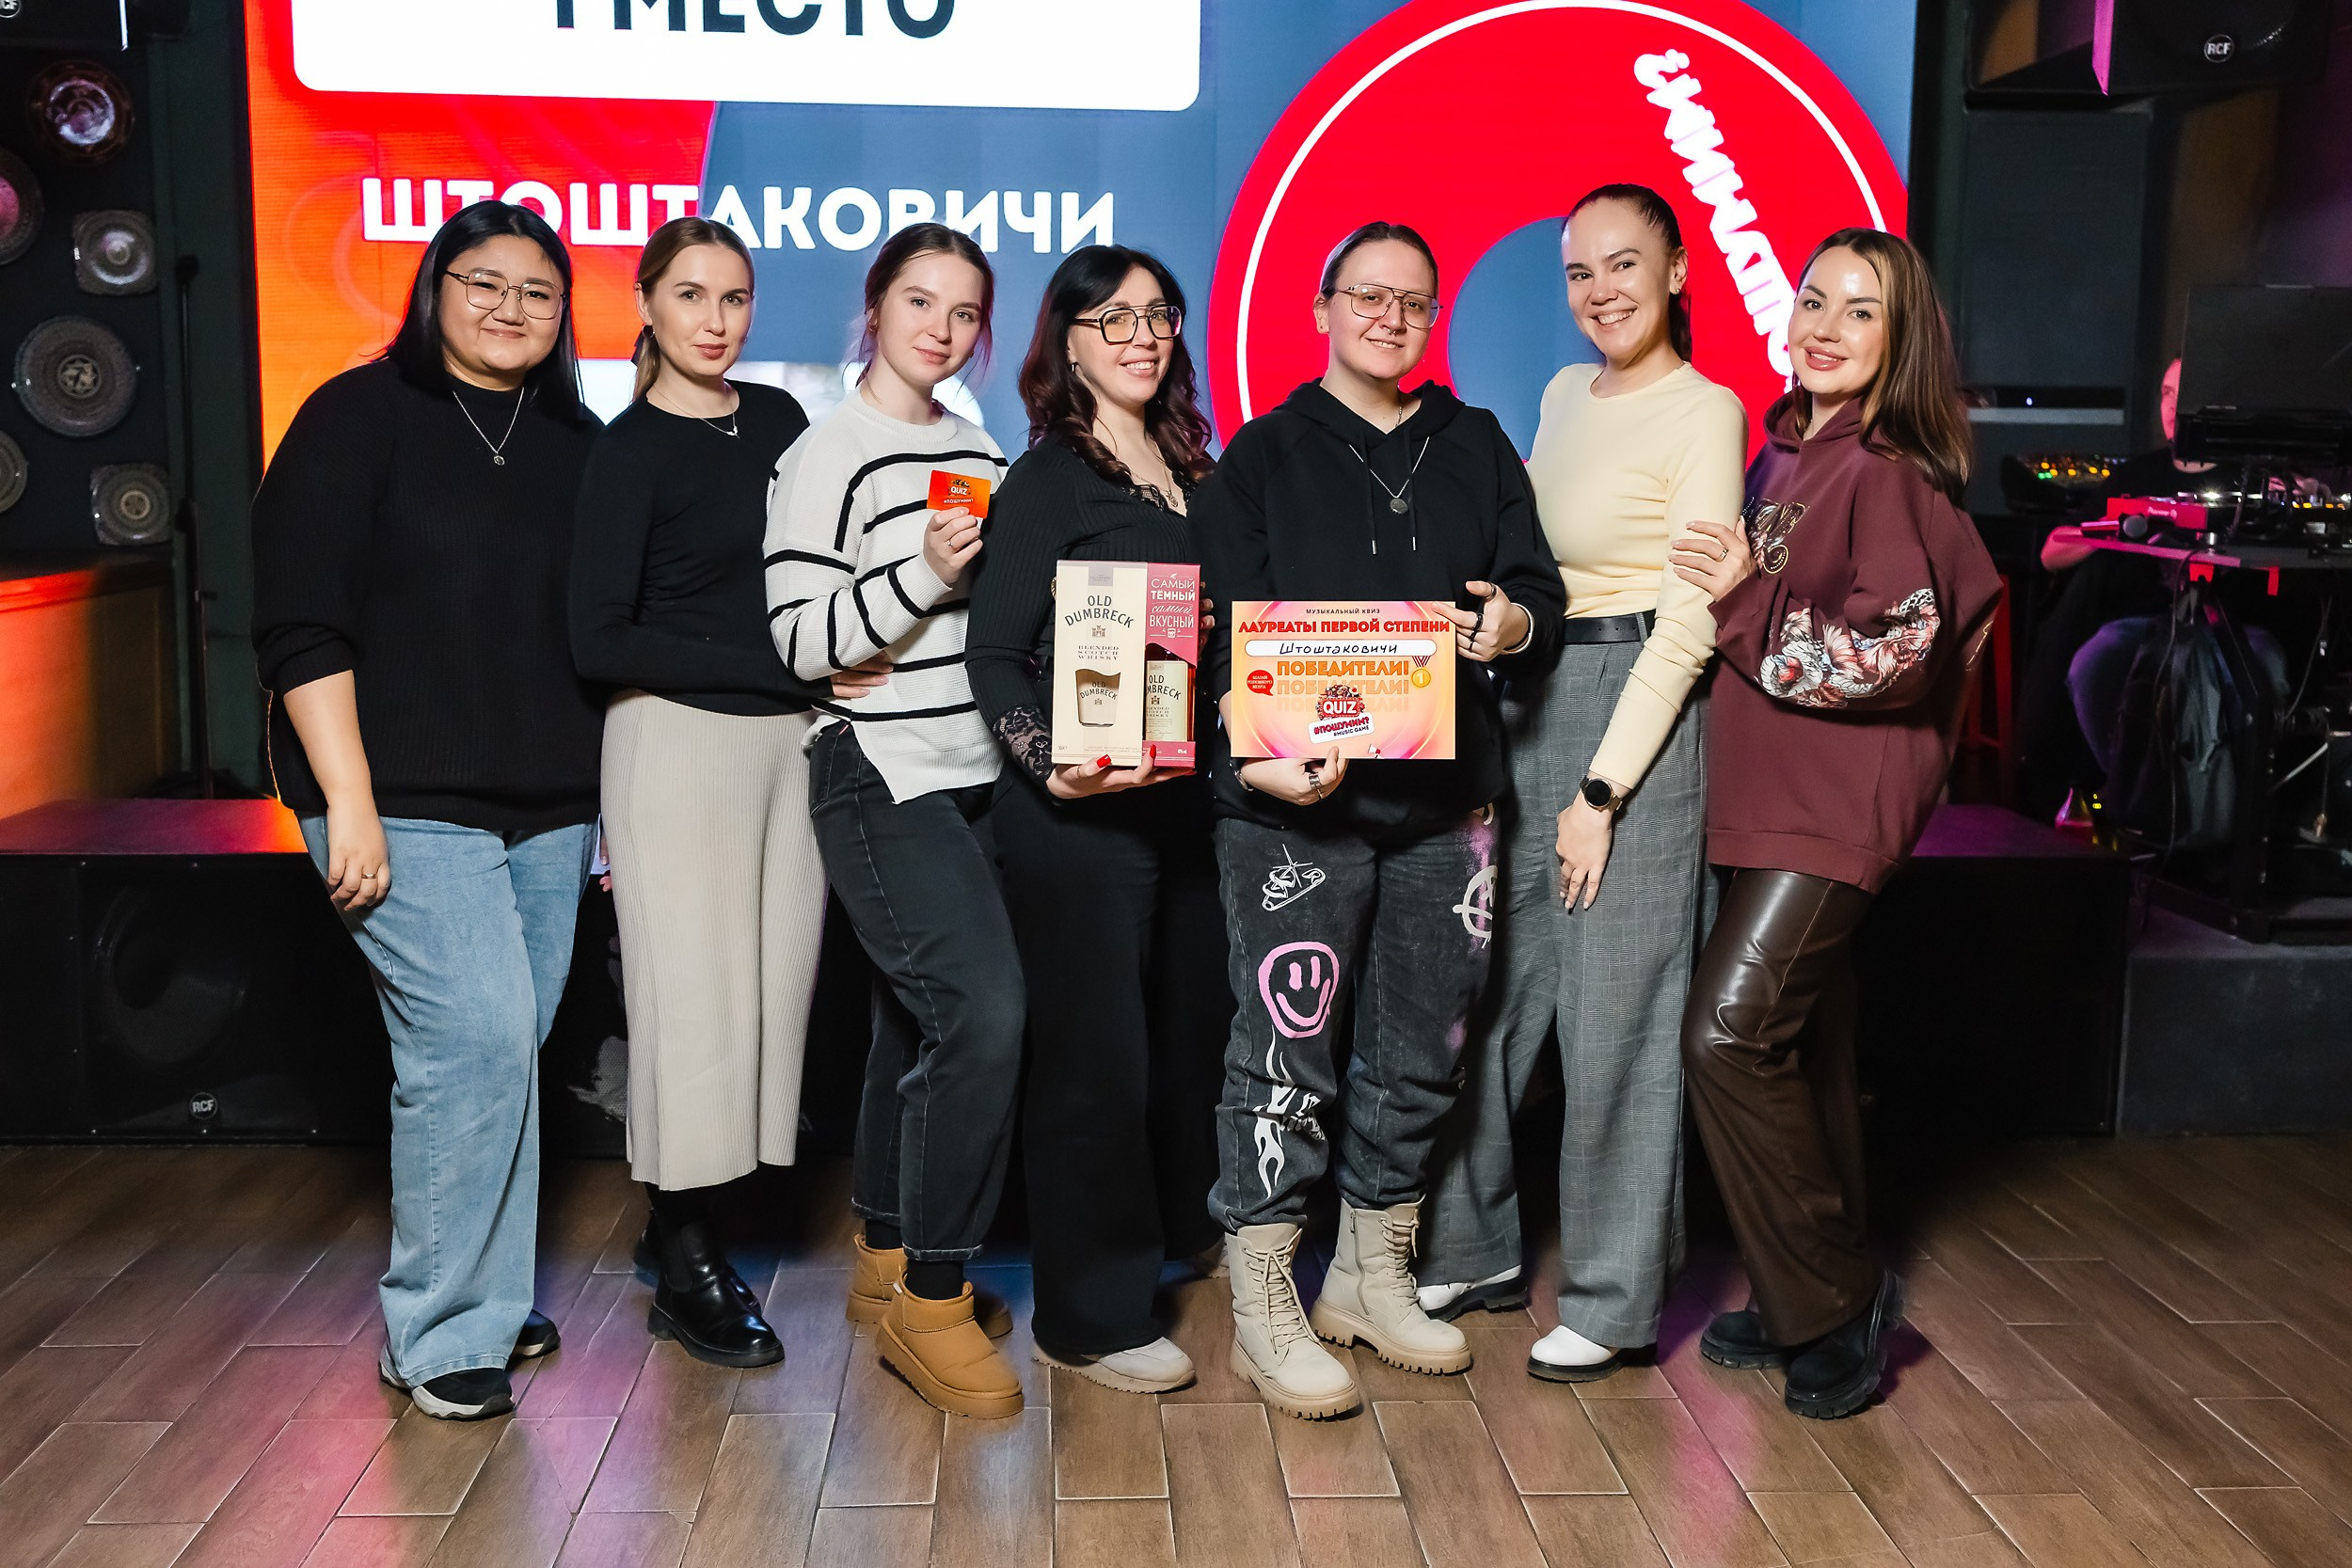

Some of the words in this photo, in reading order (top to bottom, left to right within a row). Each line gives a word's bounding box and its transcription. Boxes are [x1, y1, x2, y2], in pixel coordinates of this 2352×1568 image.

[0, 0, 17, 9] CF
[2207, 42, 2231, 55] RCF
[950, 486, 968, 496] QUIZ
[1151, 578, 1195, 589] САМЫЙ
[1088, 594, 1112, 607] OLD
[1151, 605, 1193, 614] самый
[1064, 608, 1135, 628] DUMBRECK
[1150, 614, 1194, 628] ВКУСНЫЙ
[1238, 621, 1316, 633] ЛАУРЕАТЫ
[1321, 618, 1380, 633] ПЕРВОЙ
[1383, 621, 1450, 633] СТЕПЕНИ
[1277, 660, 1409, 676] ПОБЕДИТЕЛИ!
[1148, 674, 1165, 684] OLD
[1417, 673, 1424, 684] 1
[1080, 689, 1118, 700] DUMBRECK
[1323, 701, 1357, 715] QUIZ
[193, 1100, 215, 1113] RCF
